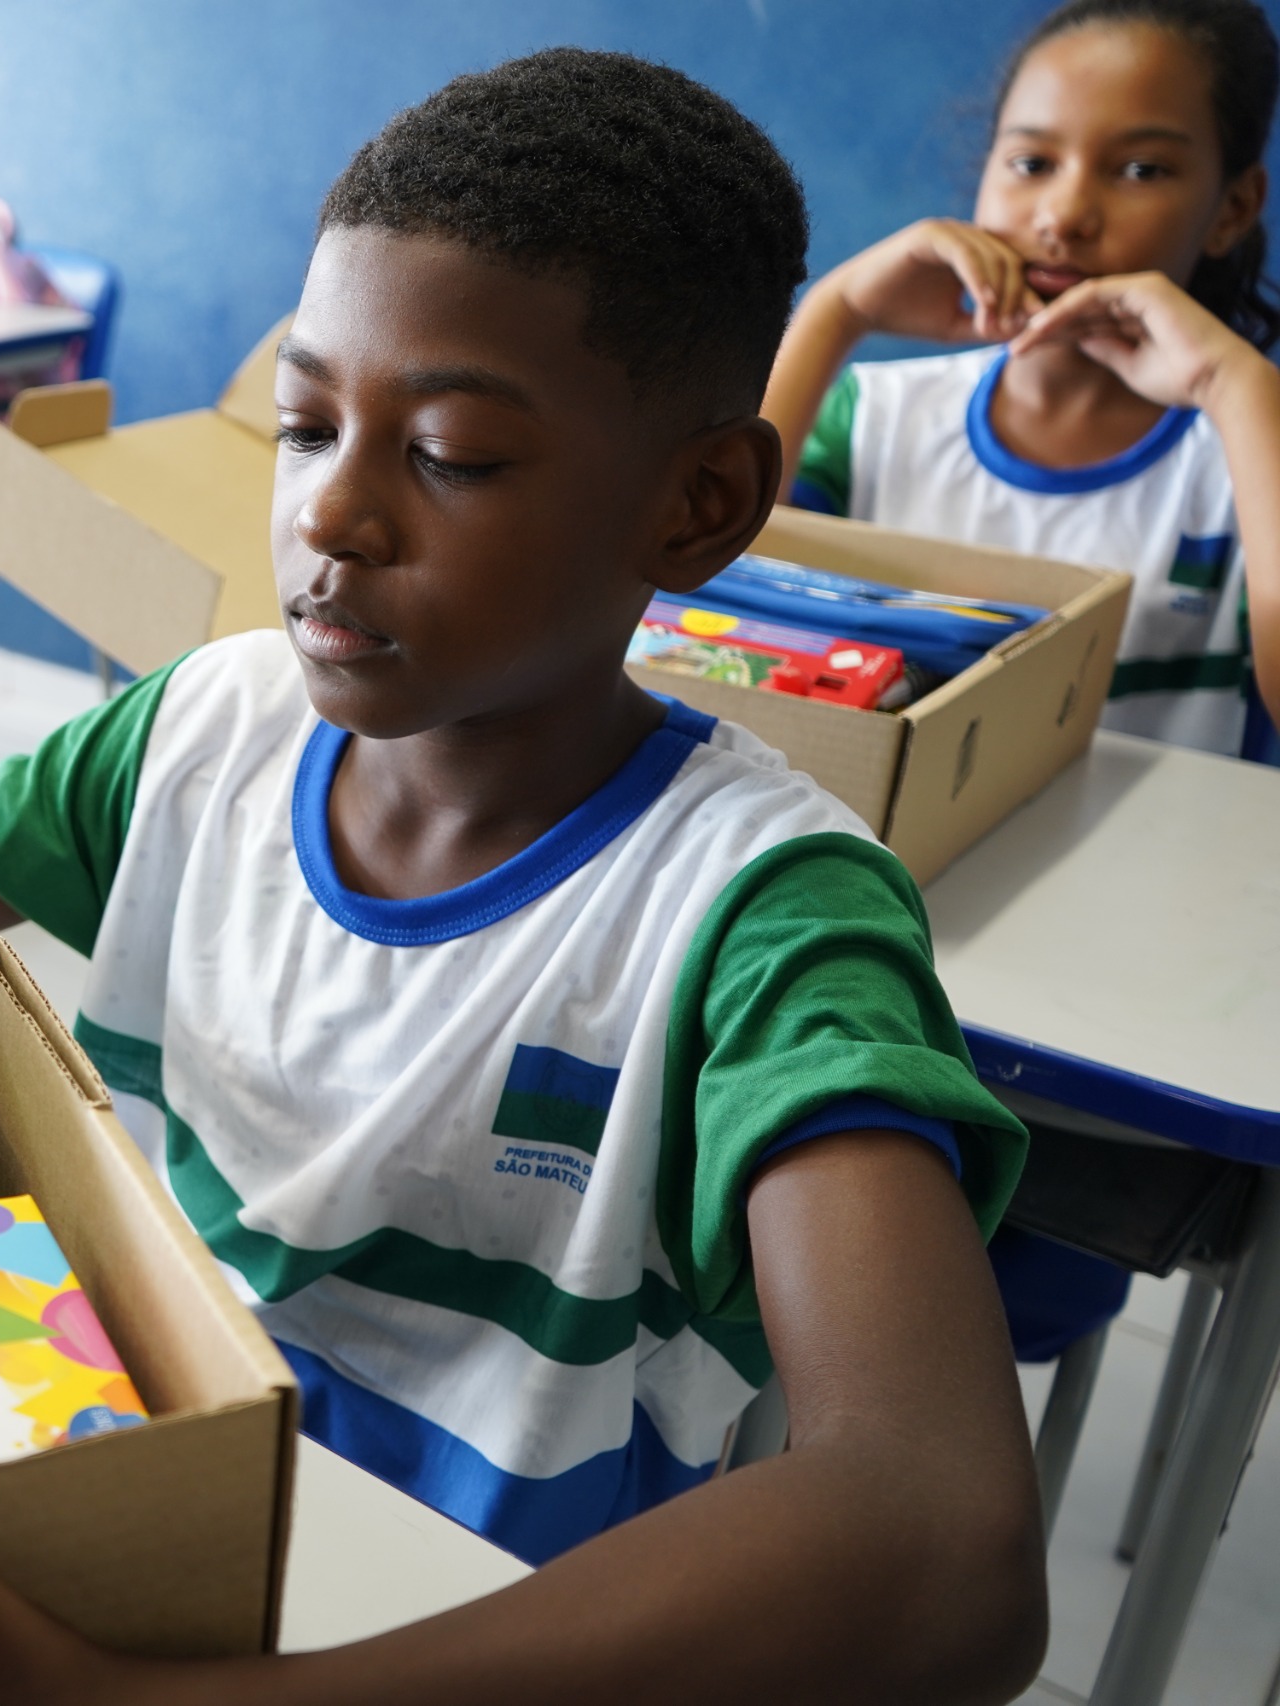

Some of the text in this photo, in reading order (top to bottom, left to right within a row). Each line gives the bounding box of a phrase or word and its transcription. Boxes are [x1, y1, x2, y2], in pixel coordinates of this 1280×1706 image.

[494, 1158, 588, 1195] SÃO MATEU
[505, 1146, 593, 1177] PREFEITURA D
